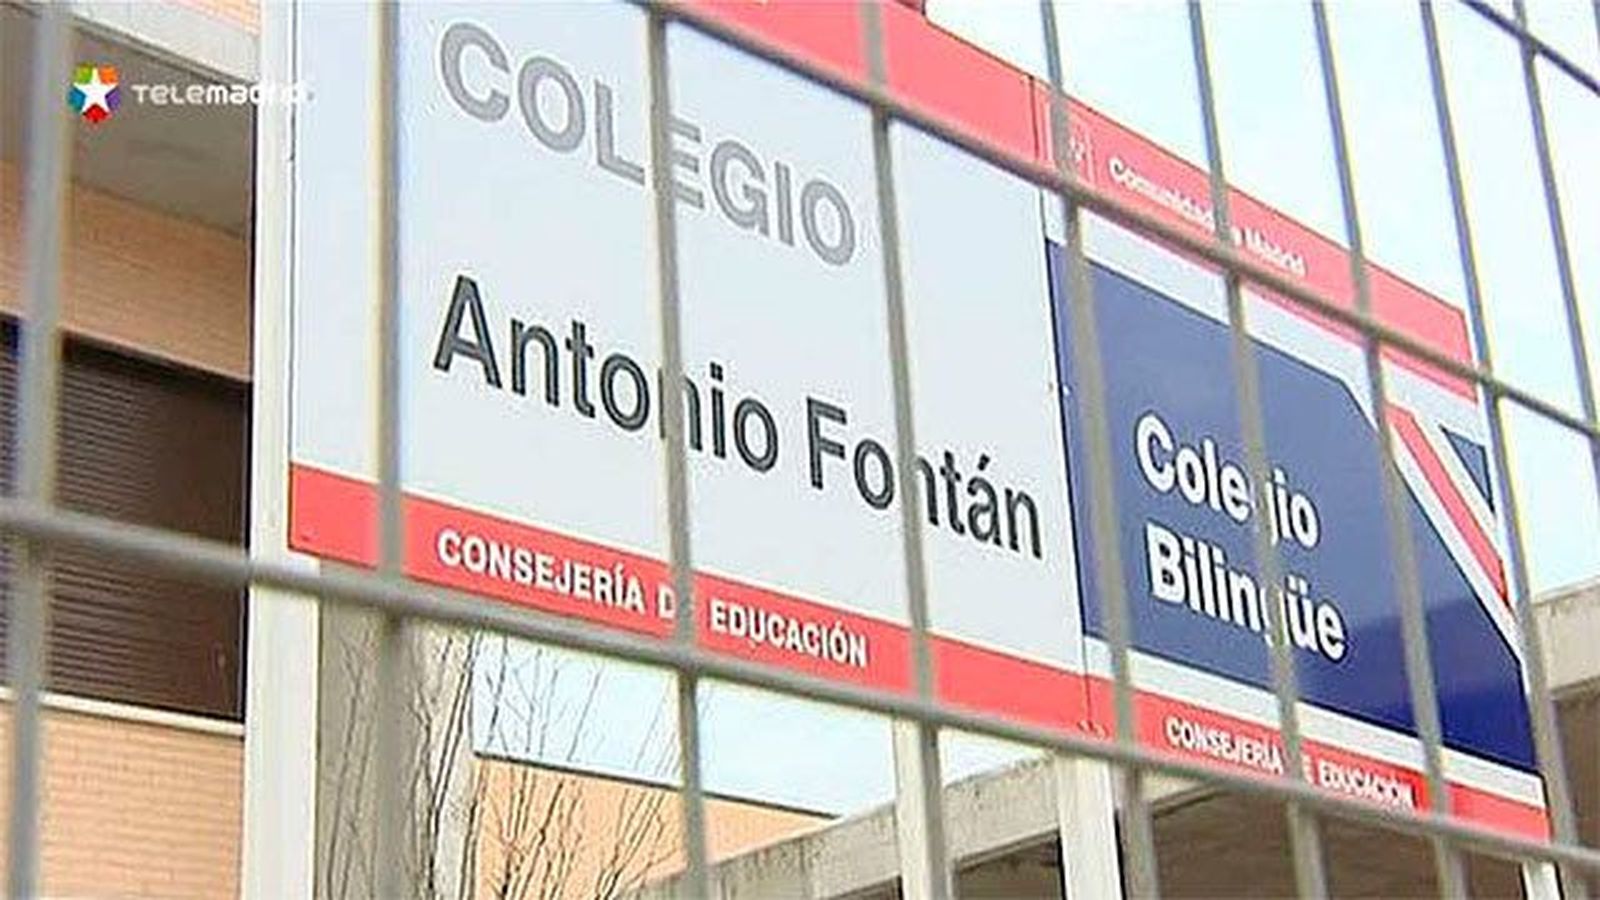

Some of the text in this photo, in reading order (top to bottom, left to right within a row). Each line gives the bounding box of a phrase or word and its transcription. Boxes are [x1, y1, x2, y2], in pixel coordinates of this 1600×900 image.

[440, 22, 855, 266] COLEGIO
[433, 274, 1042, 560] Antonio Fontán
[437, 530, 646, 615] CONSEJERÍA
[710, 599, 868, 667] EDUCACIÓN
